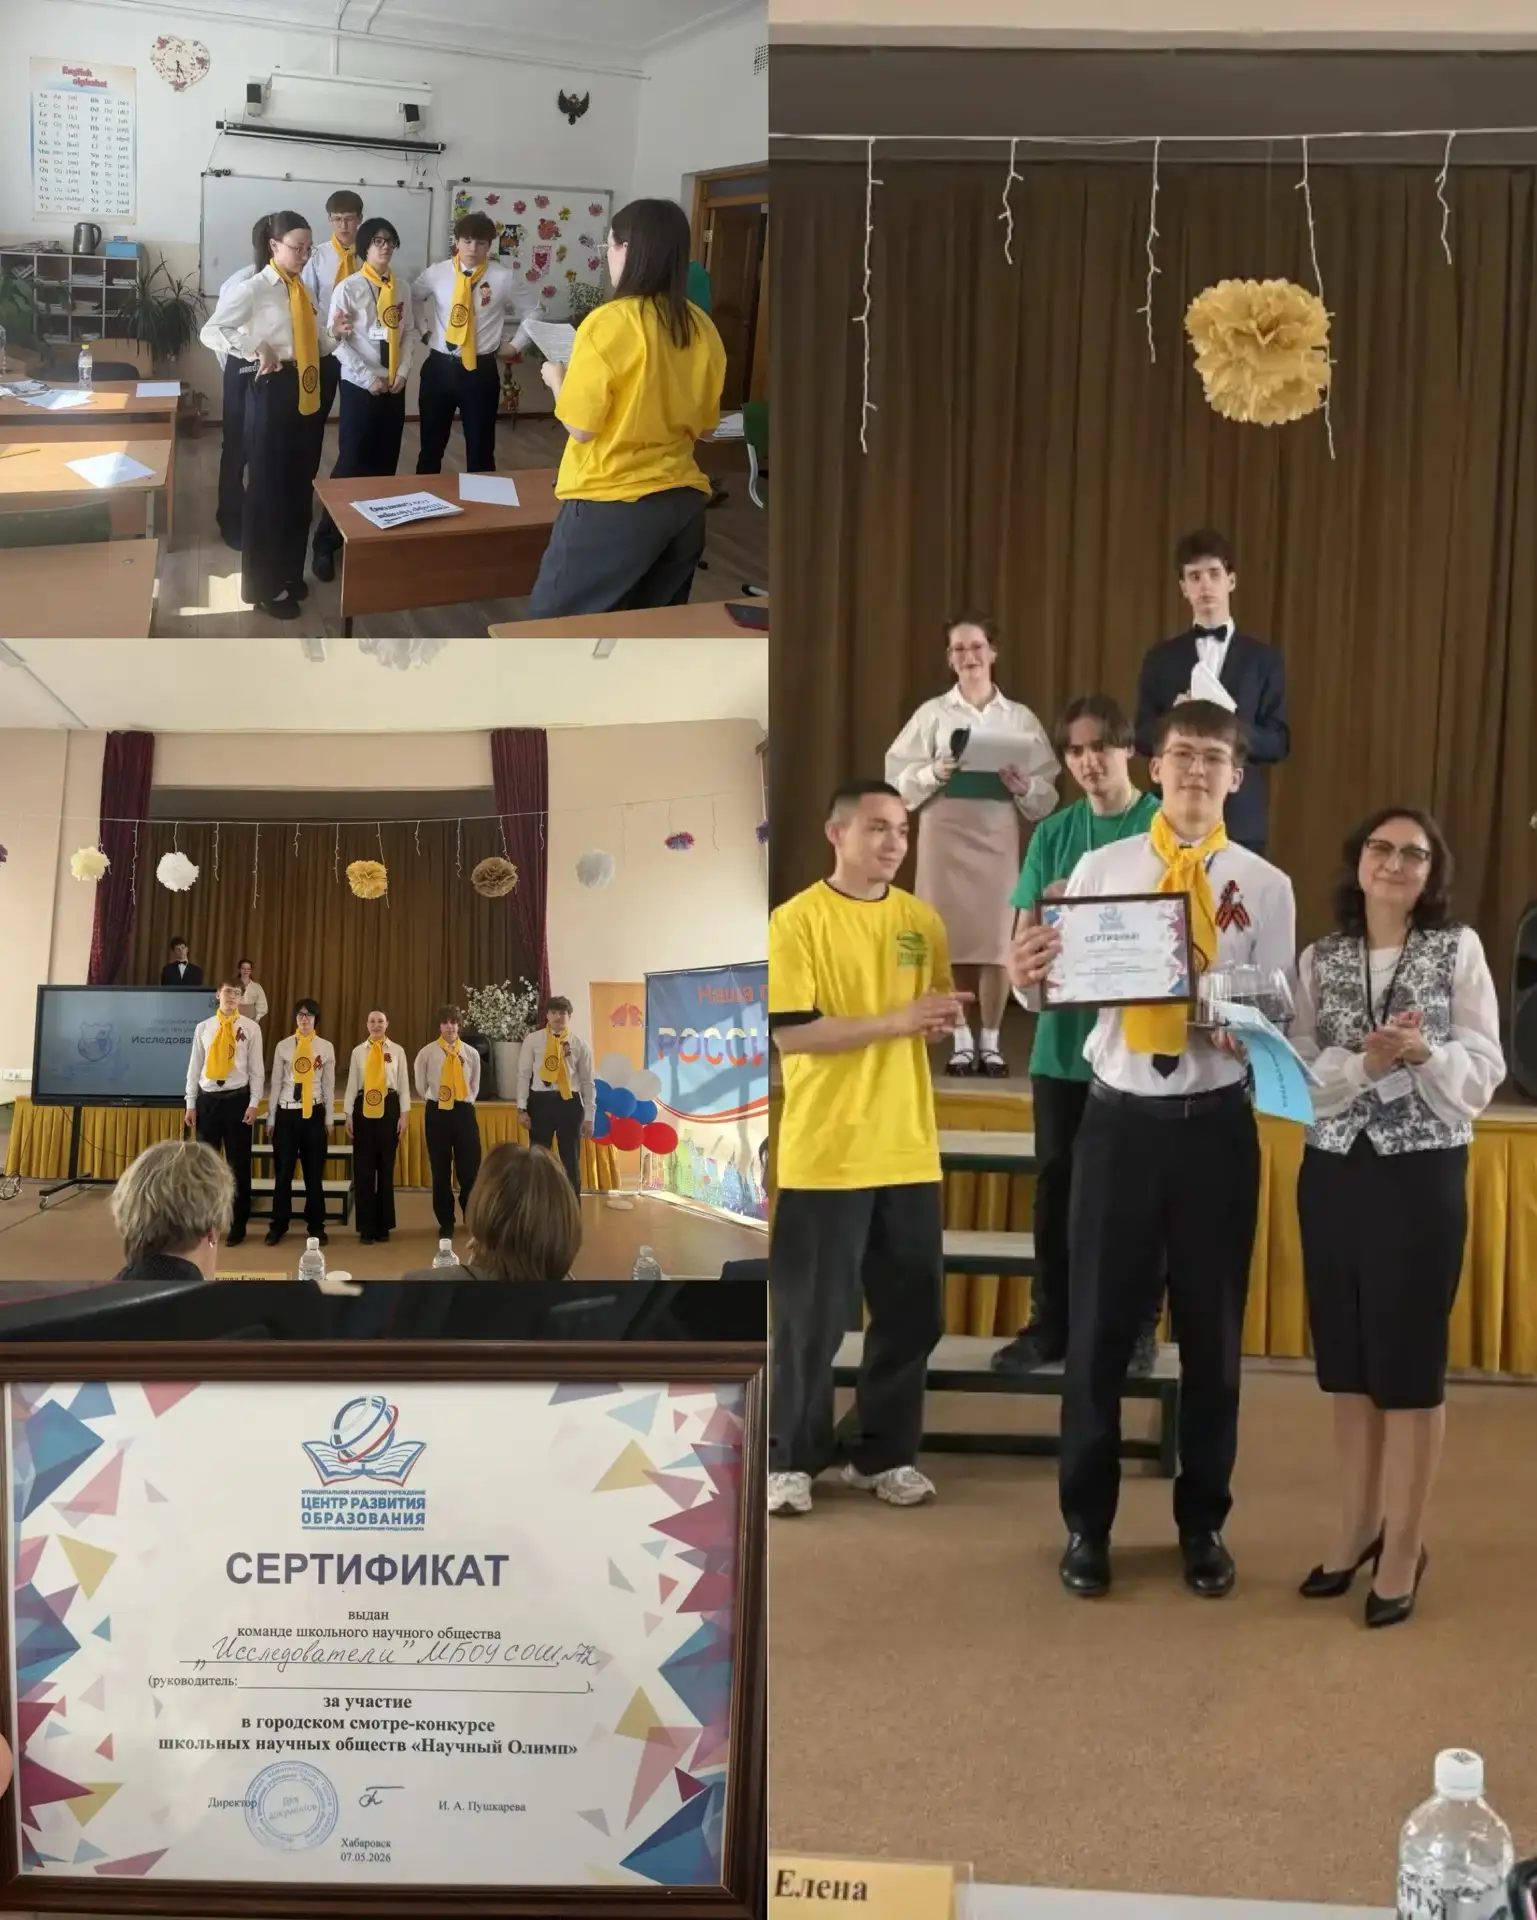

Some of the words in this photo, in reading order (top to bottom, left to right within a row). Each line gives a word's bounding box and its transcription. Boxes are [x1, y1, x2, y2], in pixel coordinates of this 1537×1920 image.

[697, 983, 754, 1004] Наша
[301, 1497, 348, 1510] ЦЕНТР
[351, 1497, 425, 1509] РАЗВИТИЯ
[301, 1511, 425, 1525] ОБРАЗОВАНИЯ
[226, 1551, 510, 1586] СЕРТИФИКАТ
[347, 1610, 389, 1621] выдан
[237, 1627, 292, 1637] команде
[296, 1627, 368, 1637] школьного
[372, 1627, 434, 1639] научного
[437, 1627, 501, 1640] общества
[148, 1675, 238, 1688] (руководитель:
[323, 1696, 340, 1708] за
[345, 1696, 412, 1711] участие
[241, 1718, 251, 1728] в
[256, 1718, 345, 1732] городском
[349, 1719, 495, 1735] смотре-конкурсе
[158, 1738, 250, 1750] школьных
[255, 1739, 331, 1754] научных
[335, 1736, 407, 1754] обществ
[411, 1738, 502, 1756] «Научный
[507, 1739, 578, 1756] Олимп»
[207, 1797, 258, 1811] Директор
[438, 1800, 450, 1811] И.
[453, 1801, 465, 1812] А.
[468, 1801, 527, 1814] Пушкарева
[340, 1838, 392, 1850] Хабаровск
[340, 1852, 392, 1864] 07.05.2026
[774, 1869, 868, 1901] Елена
